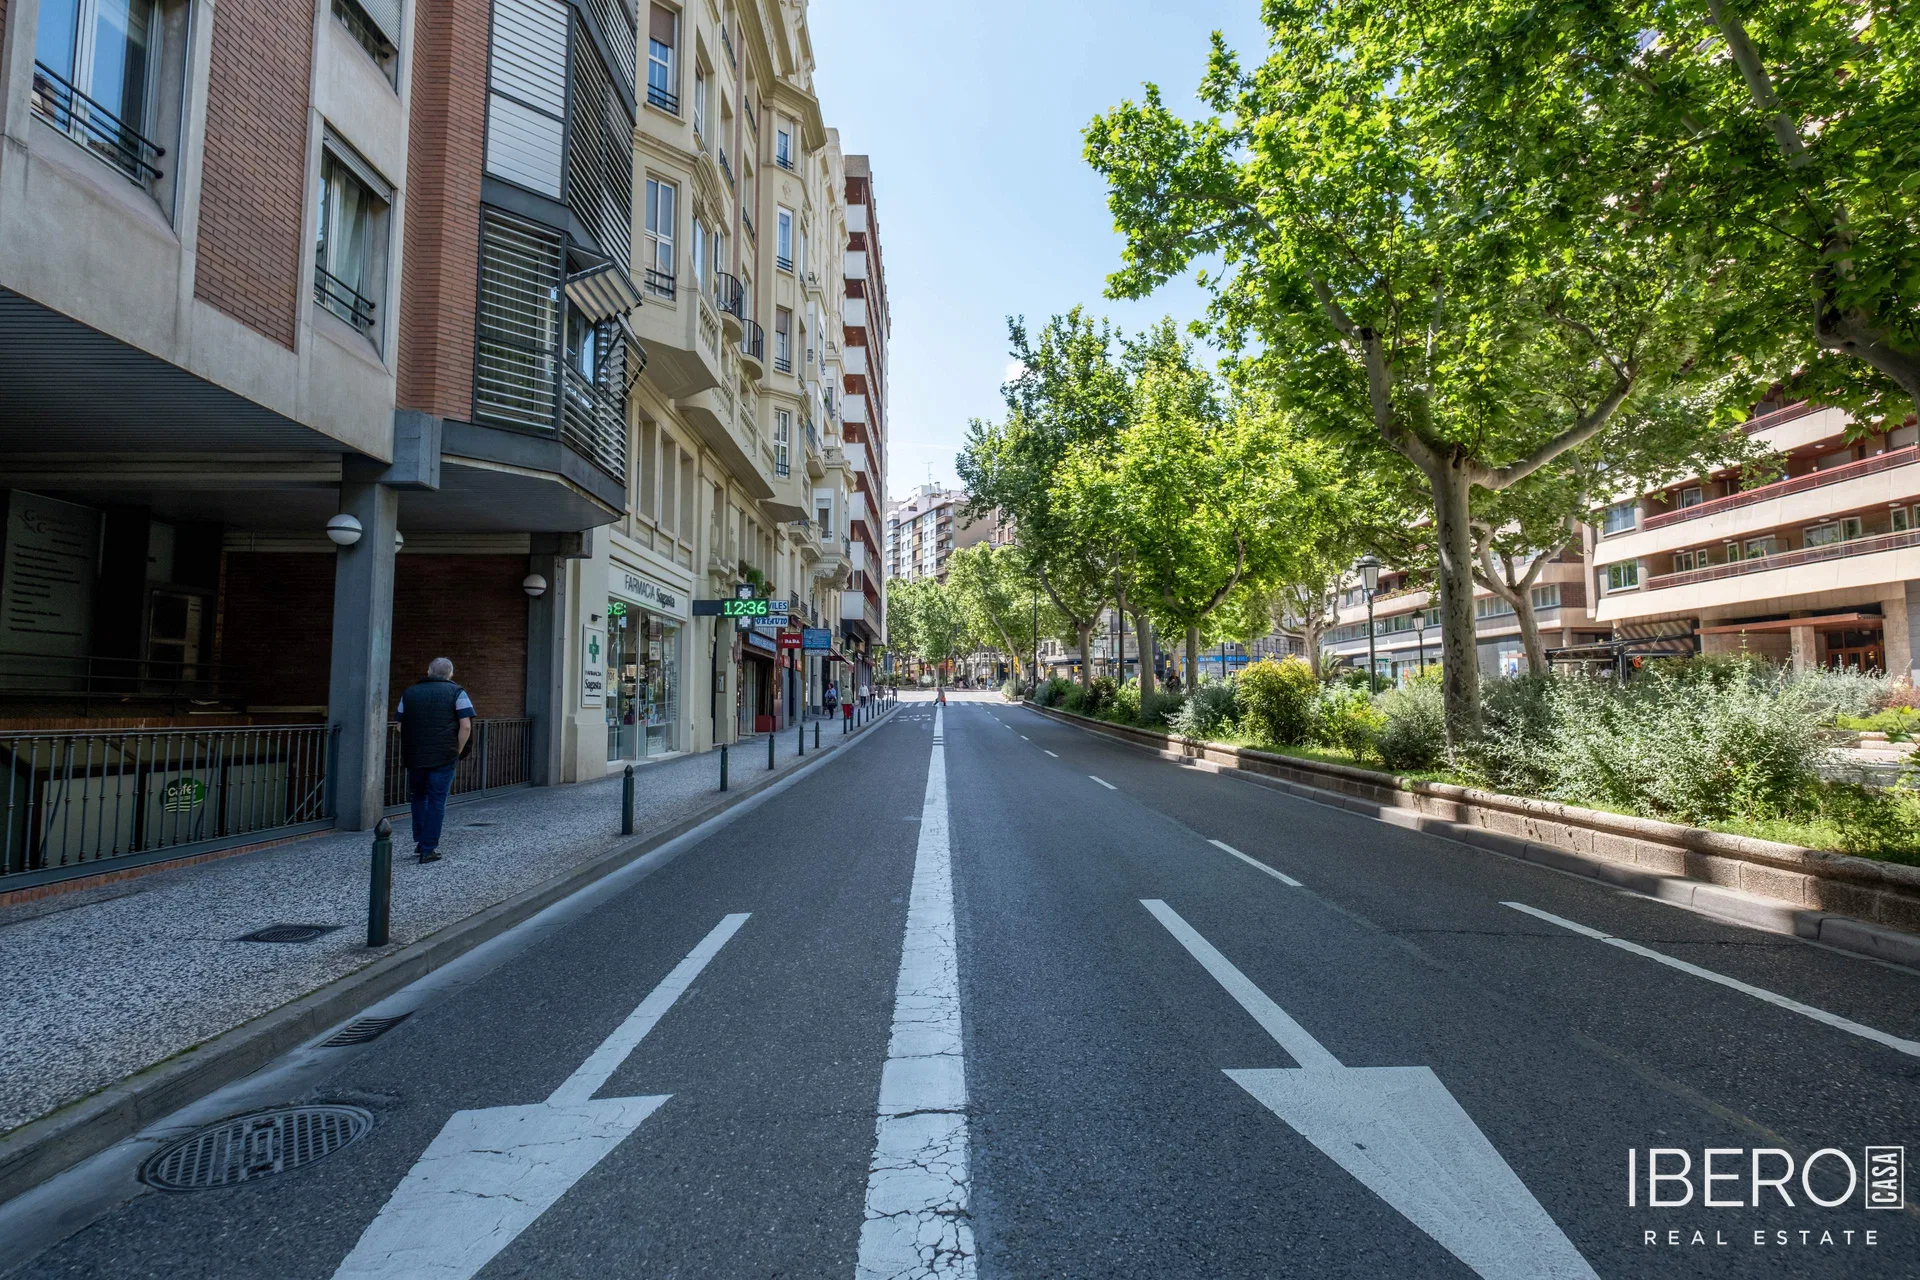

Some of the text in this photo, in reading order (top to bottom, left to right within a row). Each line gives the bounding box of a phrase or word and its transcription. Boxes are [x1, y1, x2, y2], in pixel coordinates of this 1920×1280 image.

[624, 574, 675, 608] FARMACIA Sagasta
[724, 601, 767, 615] 12:36
[585, 679, 601, 692] Sagasta
